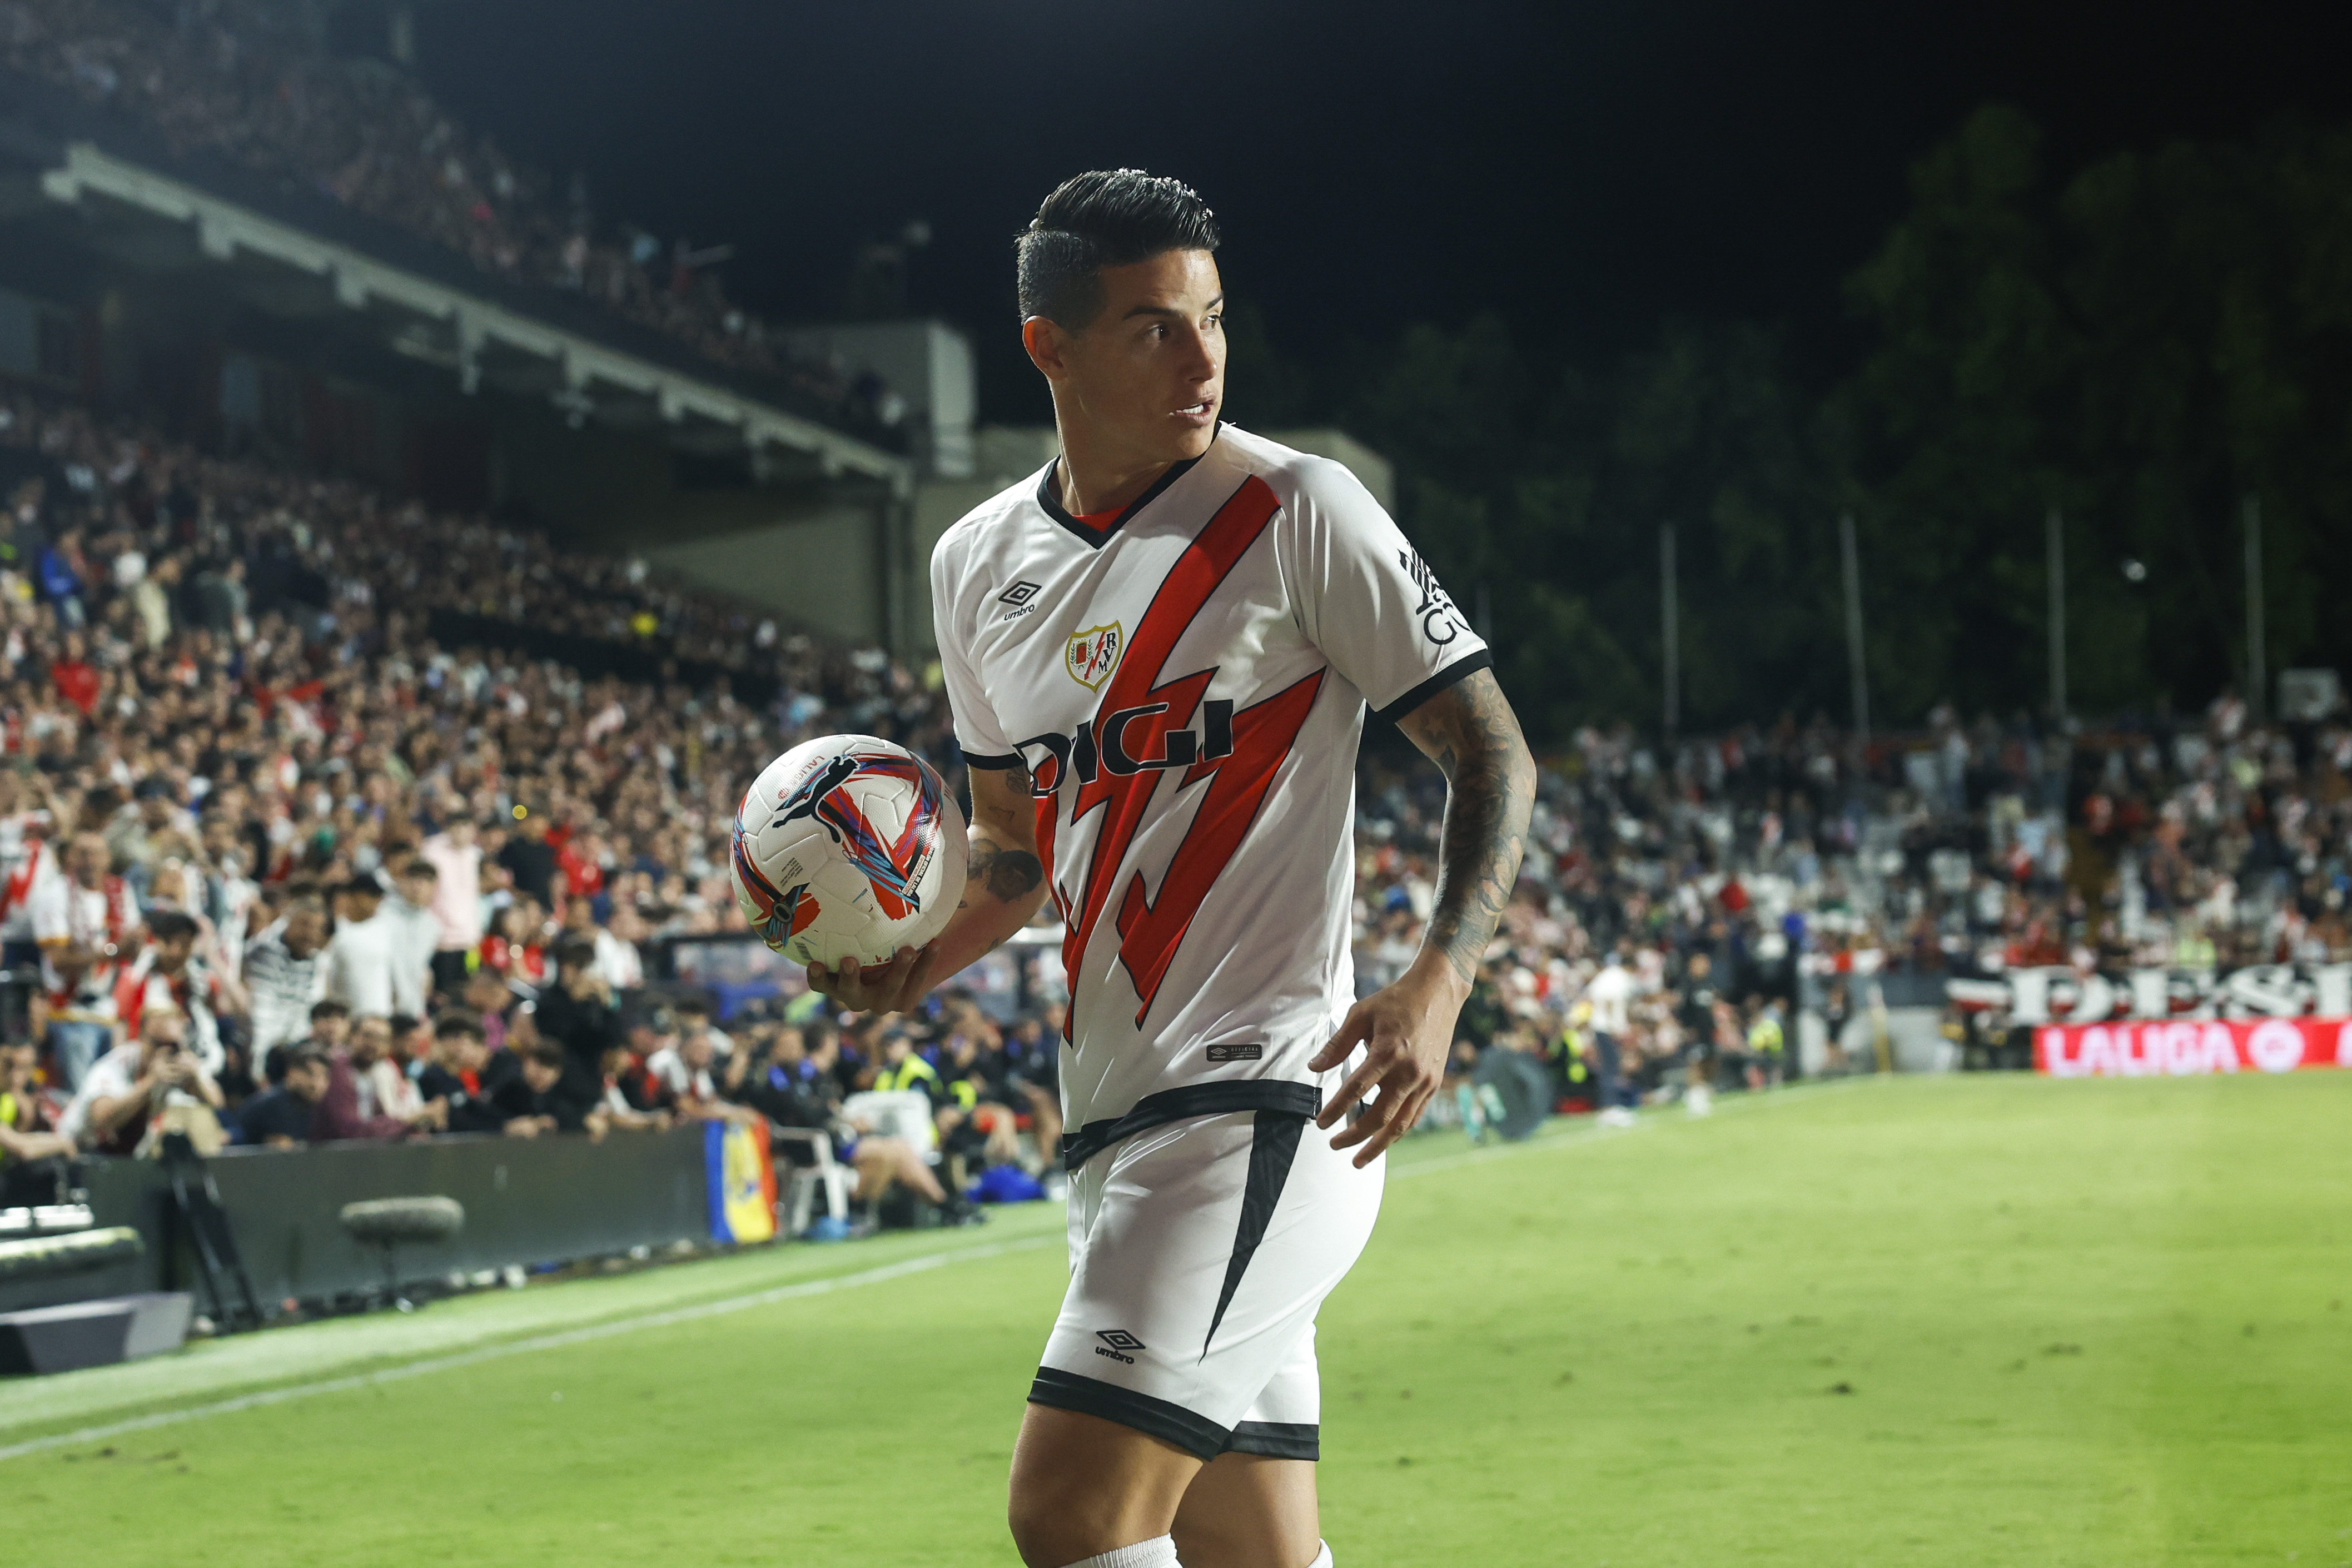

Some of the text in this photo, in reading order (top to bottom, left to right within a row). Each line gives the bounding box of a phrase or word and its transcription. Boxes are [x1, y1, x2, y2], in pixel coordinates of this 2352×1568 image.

[1004, 604, 1035, 621] umbro
[1012, 699, 1234, 799] DIGI
[2042, 1023, 2239, 1077] LALIGA
[1095, 1346, 1135, 1364] umbro
